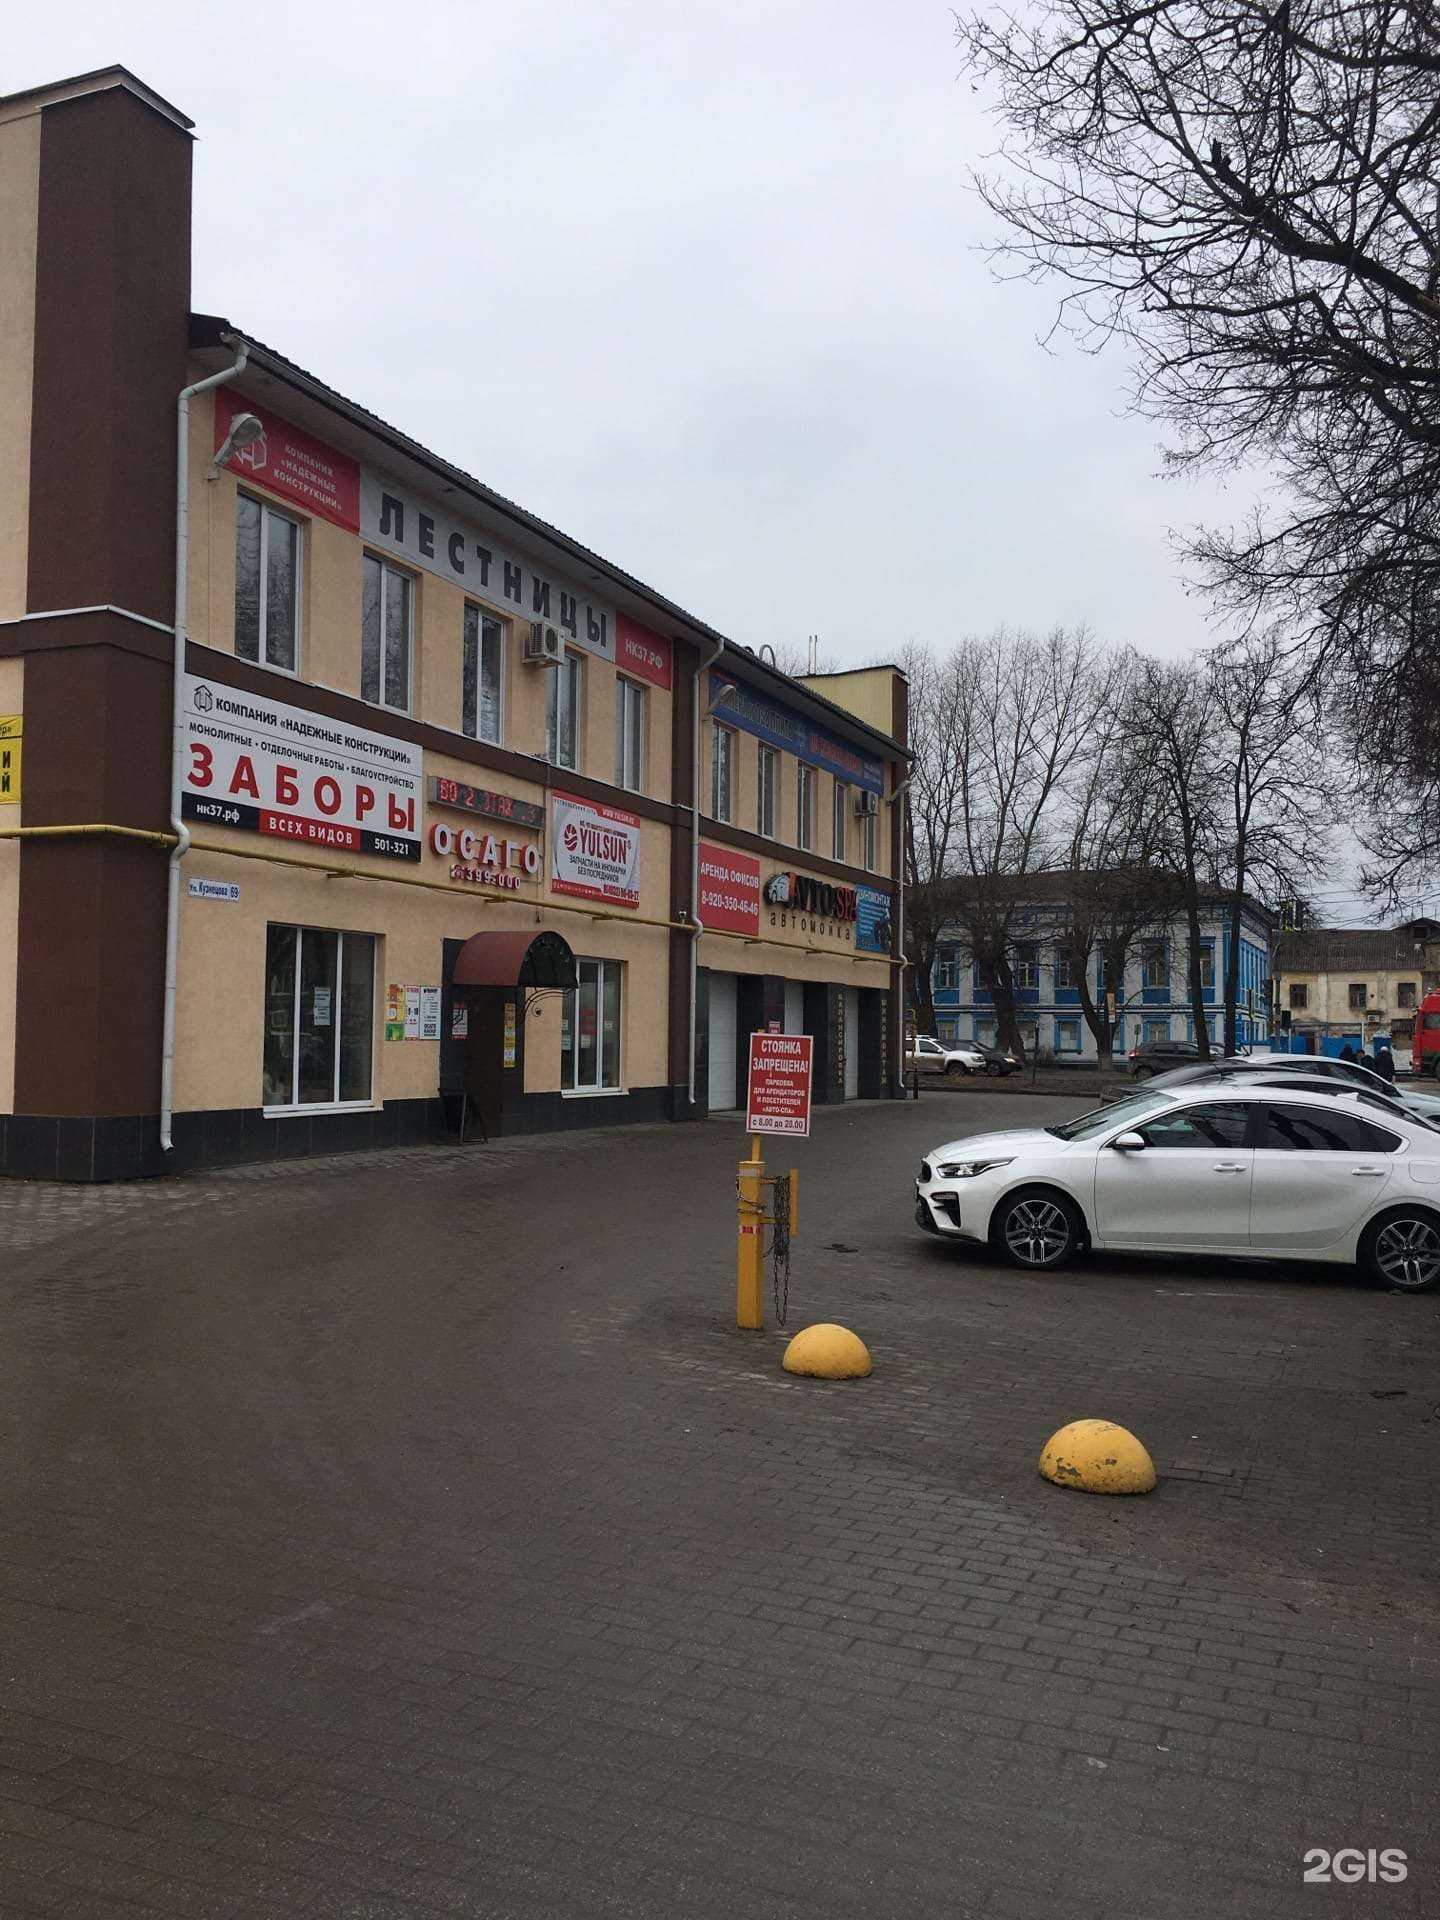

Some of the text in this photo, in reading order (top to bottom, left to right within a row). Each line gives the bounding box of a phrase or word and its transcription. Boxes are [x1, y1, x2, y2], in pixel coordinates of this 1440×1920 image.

[285, 444, 333, 477] КОМПАНИЯ
[379, 492, 607, 648] ЛЕСТНИЦЫ
[625, 638, 663, 669] НК37.РФ
[216, 697, 411, 765] КОМПАНИЯ «НАДЕЖНЫЕ КОНСТРУКЦИИ»
[189, 721, 414, 790] МОНОЛИТНЫЕ ОТДЕЛОЧНЫЕ РАБОТЫ БЛАГОУСТРОЙСТВО
[187, 743, 415, 832] ЗАБОРЫ
[196, 803, 240, 824] нк37.рф
[269, 817, 353, 845] ВСЕХ ВИДОВ
[374, 837, 409, 855] 501-321
[430, 823, 541, 874] ОСАГО
[579, 827, 627, 865] YULSUN
[700, 862, 759, 889] АРЕНДА ОФИСОВ
[770, 911, 850, 940] автомойка
[761, 1039, 802, 1055] СТОЯНКА
[752, 1057, 809, 1075] ЗАПРЕЩЕНА!
[765, 1079, 794, 1087] ПАРКОВКА
[774, 1120, 783, 1128] до
[784, 1120, 803, 1129] 20.00
